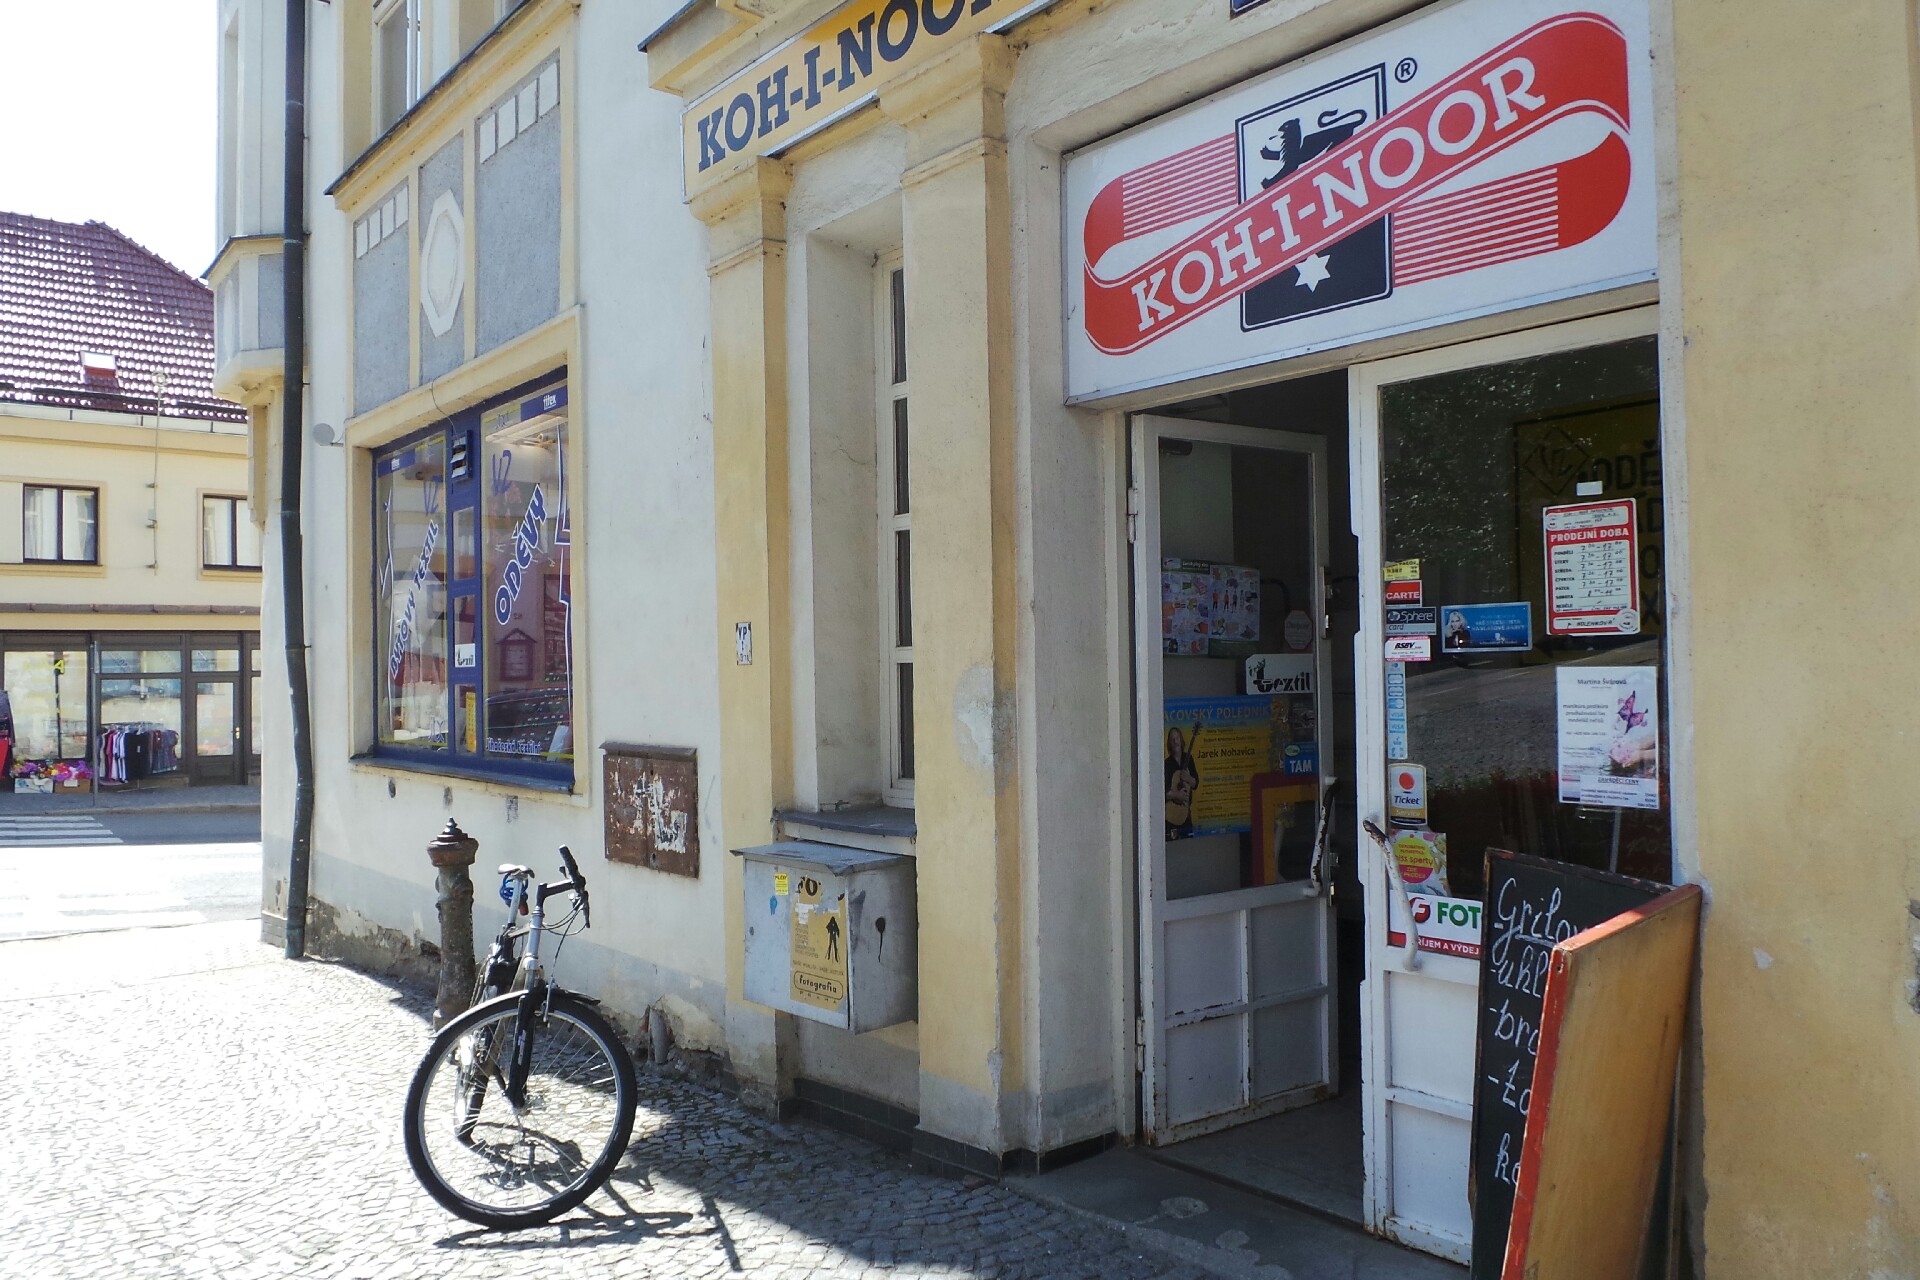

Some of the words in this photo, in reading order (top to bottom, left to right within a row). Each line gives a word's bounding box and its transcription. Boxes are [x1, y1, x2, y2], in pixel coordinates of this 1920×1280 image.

[697, 0, 1001, 172] KOH-I-NOO
[1131, 56, 1546, 332] KOH-I-NOOR
[1550, 530, 1598, 542] PRODEJNÍ
[1600, 528, 1629, 537] DOBA
[413, 519, 440, 594] TEXTIL
[495, 483, 548, 626] ODĚVY
[1386, 591, 1420, 600] CARTE
[1400, 611, 1433, 623] Sphere
[1197, 749, 1219, 759] Jarek
[1220, 746, 1256, 758] Nohavica
[1289, 759, 1312, 773] TAM
[1394, 795, 1420, 805] Ticket
[1437, 901, 1481, 929] FOT
[1442, 942, 1449, 950] A
[1450, 942, 1479, 955] VÝDEJ
